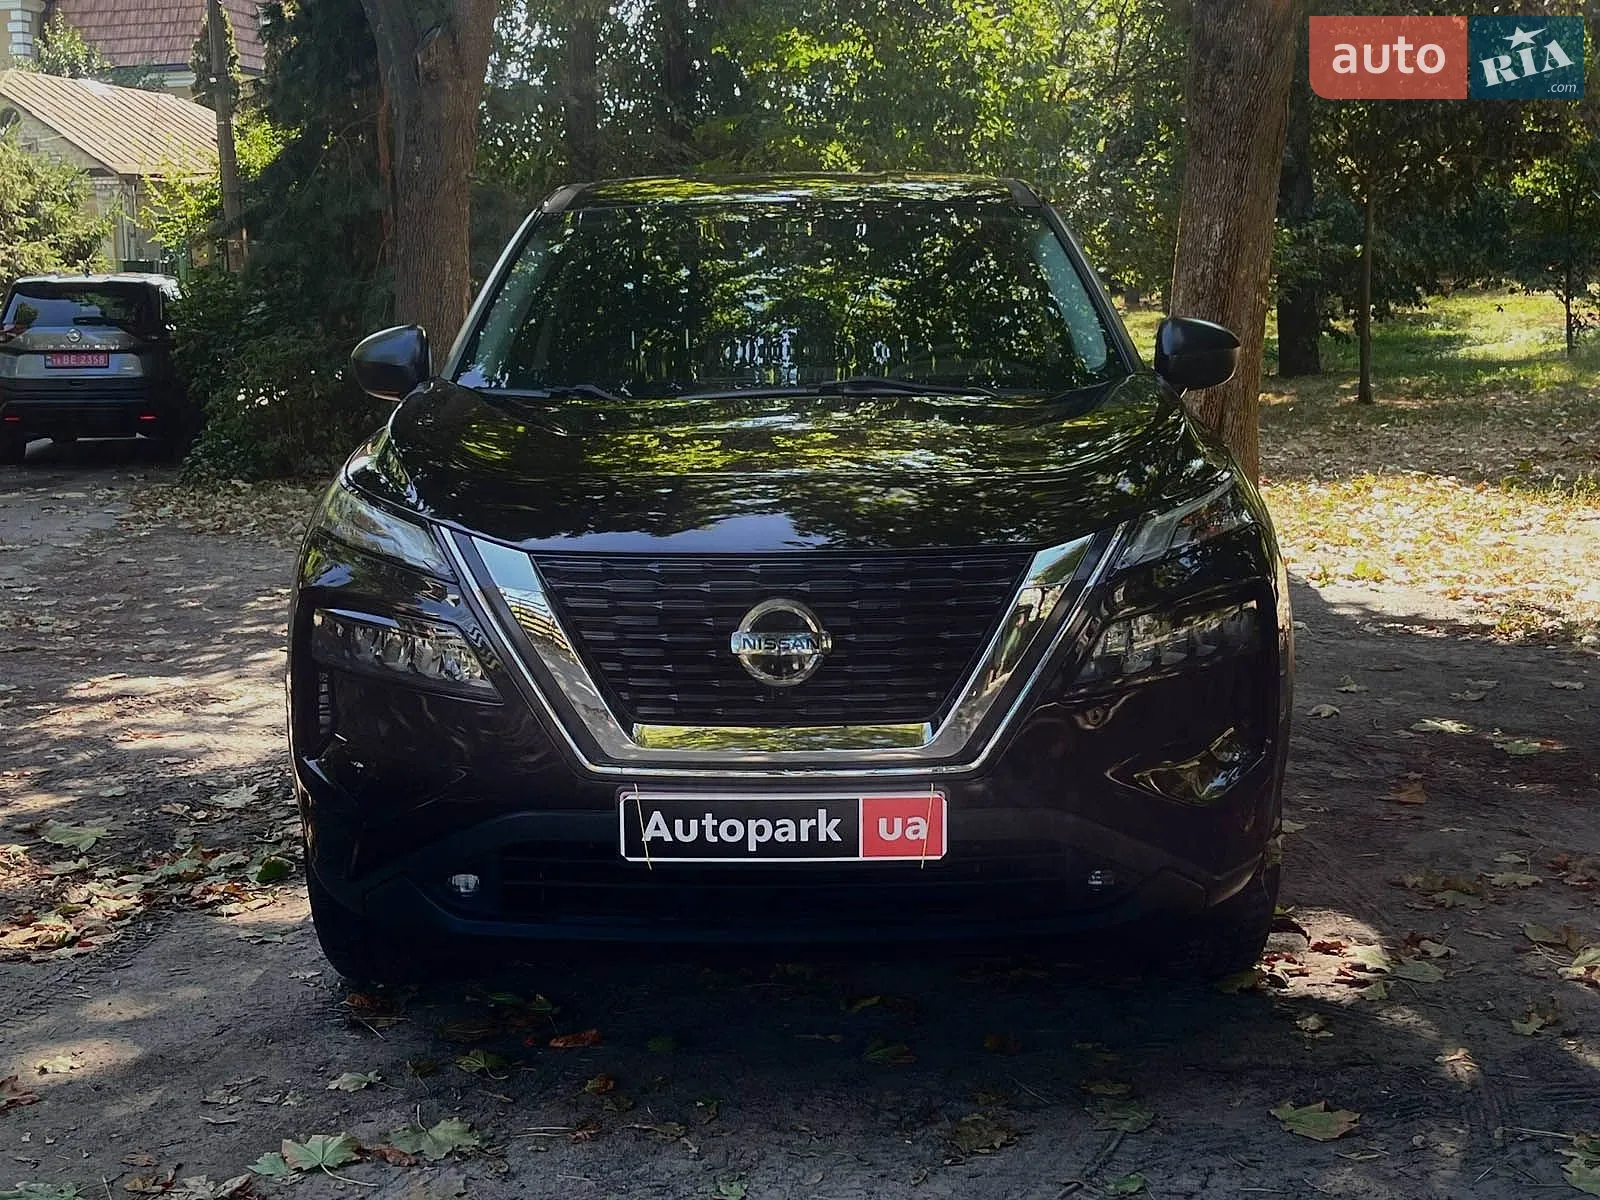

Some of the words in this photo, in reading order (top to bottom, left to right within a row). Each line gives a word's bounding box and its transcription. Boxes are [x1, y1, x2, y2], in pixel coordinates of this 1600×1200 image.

[742, 638, 818, 650] NISSAN
[641, 808, 842, 853] Autopark
[877, 815, 928, 842] ua
